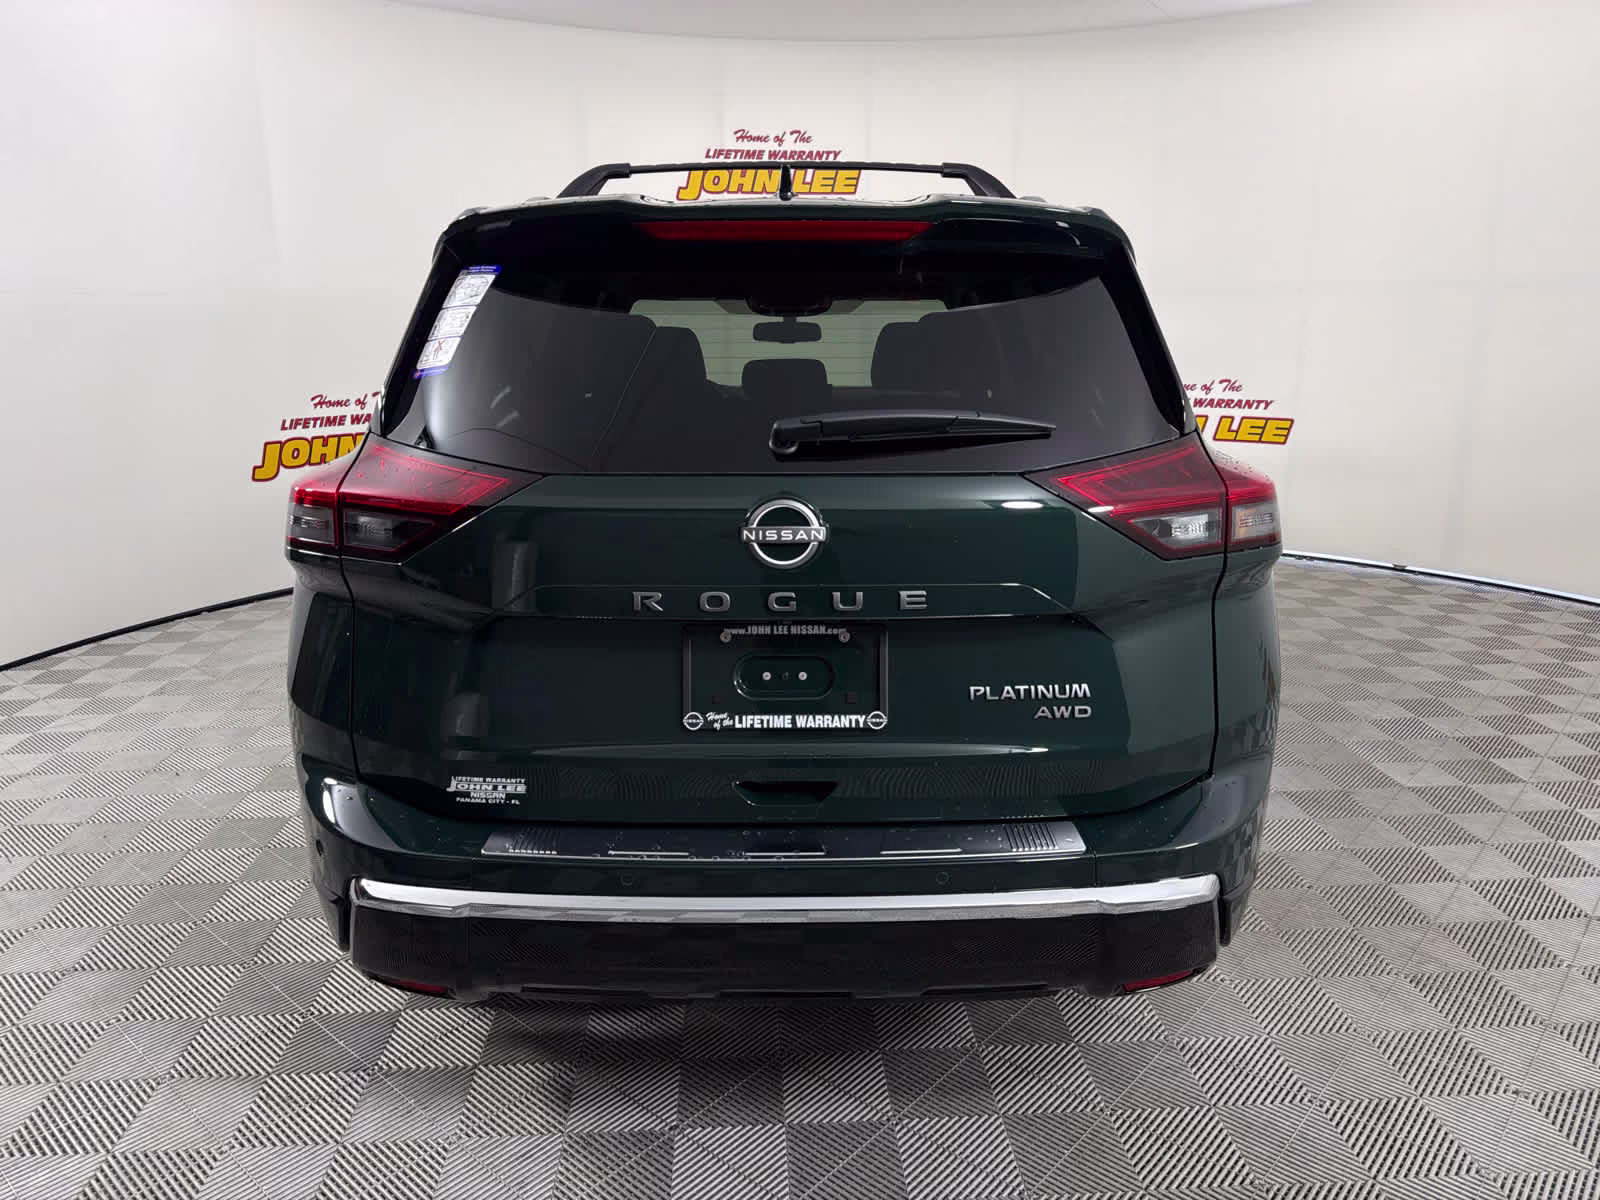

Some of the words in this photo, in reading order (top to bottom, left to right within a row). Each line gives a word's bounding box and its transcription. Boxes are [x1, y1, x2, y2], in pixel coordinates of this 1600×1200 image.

[733, 129, 770, 143] Home
[773, 132, 785, 147] of
[789, 130, 813, 144] The
[705, 148, 764, 160] LIFETIME
[767, 150, 842, 161] WARRANTY
[676, 168, 782, 200] JOHN
[790, 168, 861, 194] LEE
[1200, 380, 1215, 395] of
[1218, 378, 1243, 393] The
[310, 394, 351, 409] Home
[354, 394, 367, 410] of
[1193, 398, 1273, 410] WARRANTY
[280, 415, 347, 431] LIFETIME
[1212, 416, 1294, 445] LEE
[743, 530, 824, 541] NISSAN
[632, 590, 928, 612] ROGUE
[969, 683, 1091, 700] PLATINUM
[1034, 706, 1092, 719] AWD
[735, 715, 792, 729] LIFETIME
[796, 715, 866, 729] WARRANTY
